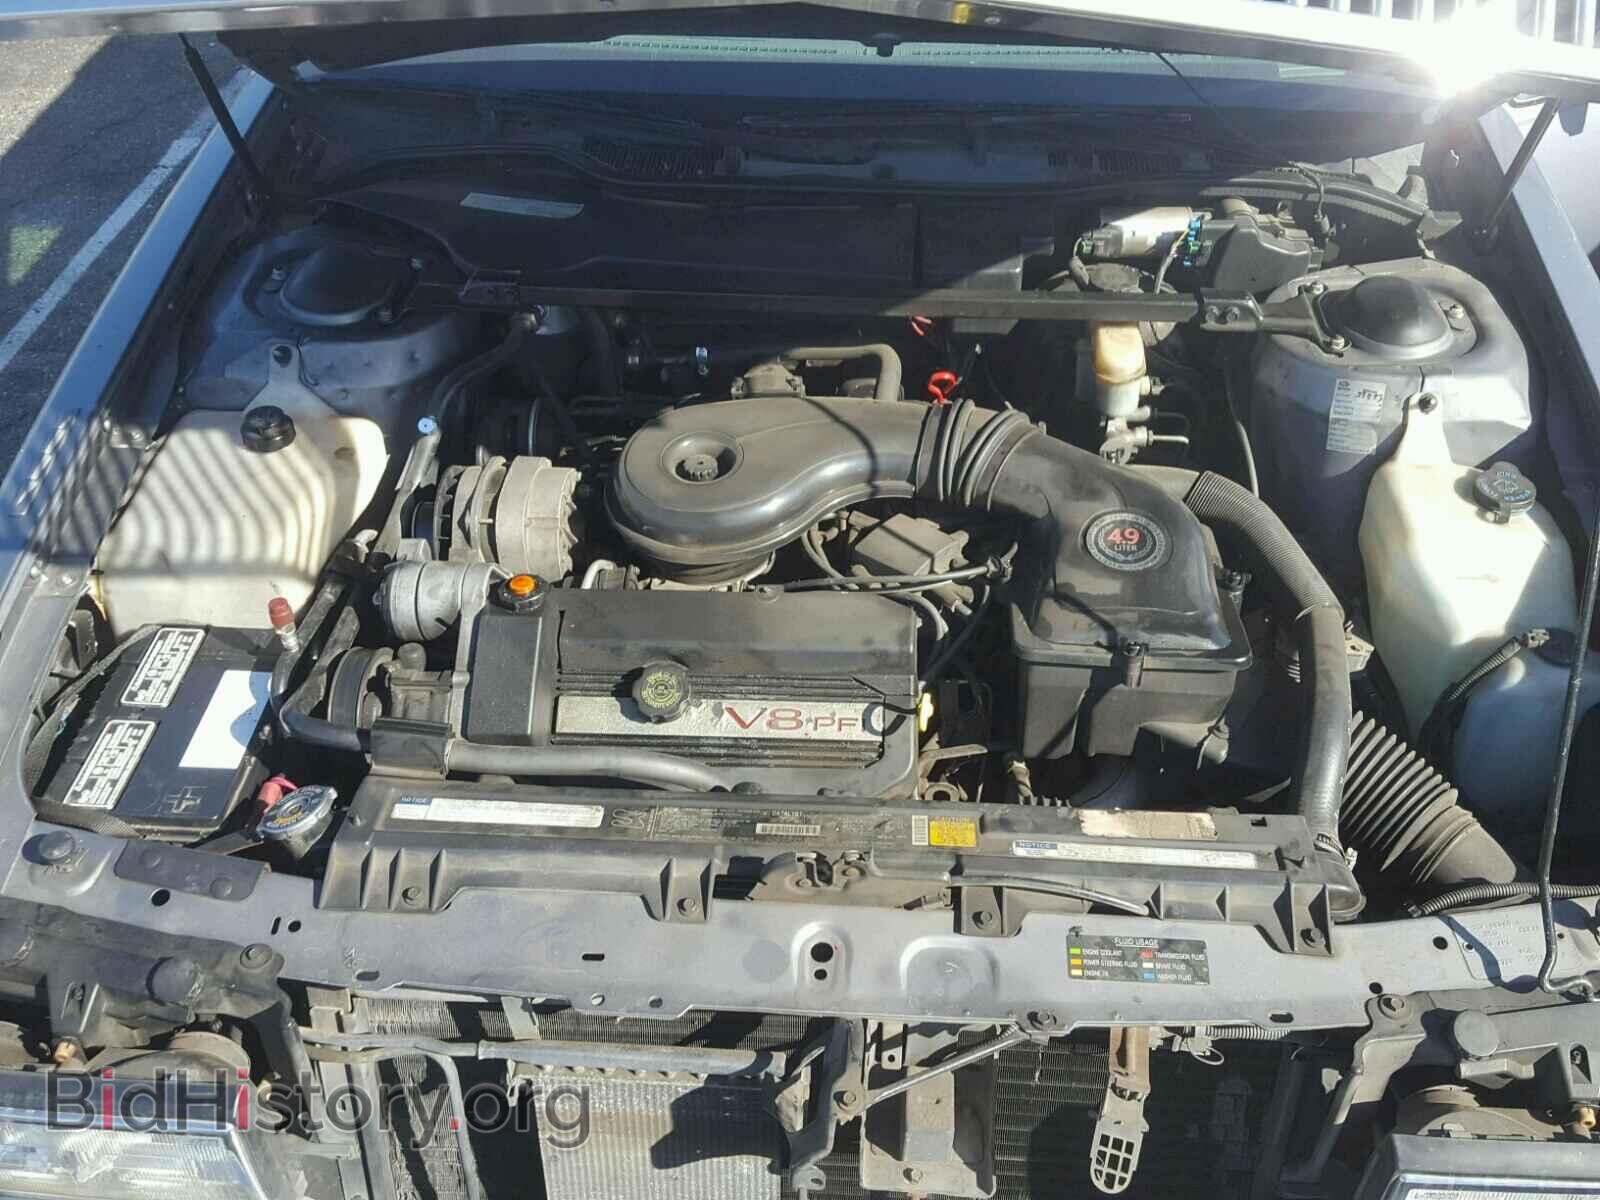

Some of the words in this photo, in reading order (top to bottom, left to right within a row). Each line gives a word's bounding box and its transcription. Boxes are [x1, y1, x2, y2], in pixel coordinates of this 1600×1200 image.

[725, 706, 804, 731] V8
[814, 716, 865, 732] PF
[1114, 937, 1134, 946] FLUID
[1135, 938, 1159, 947] USAGE
